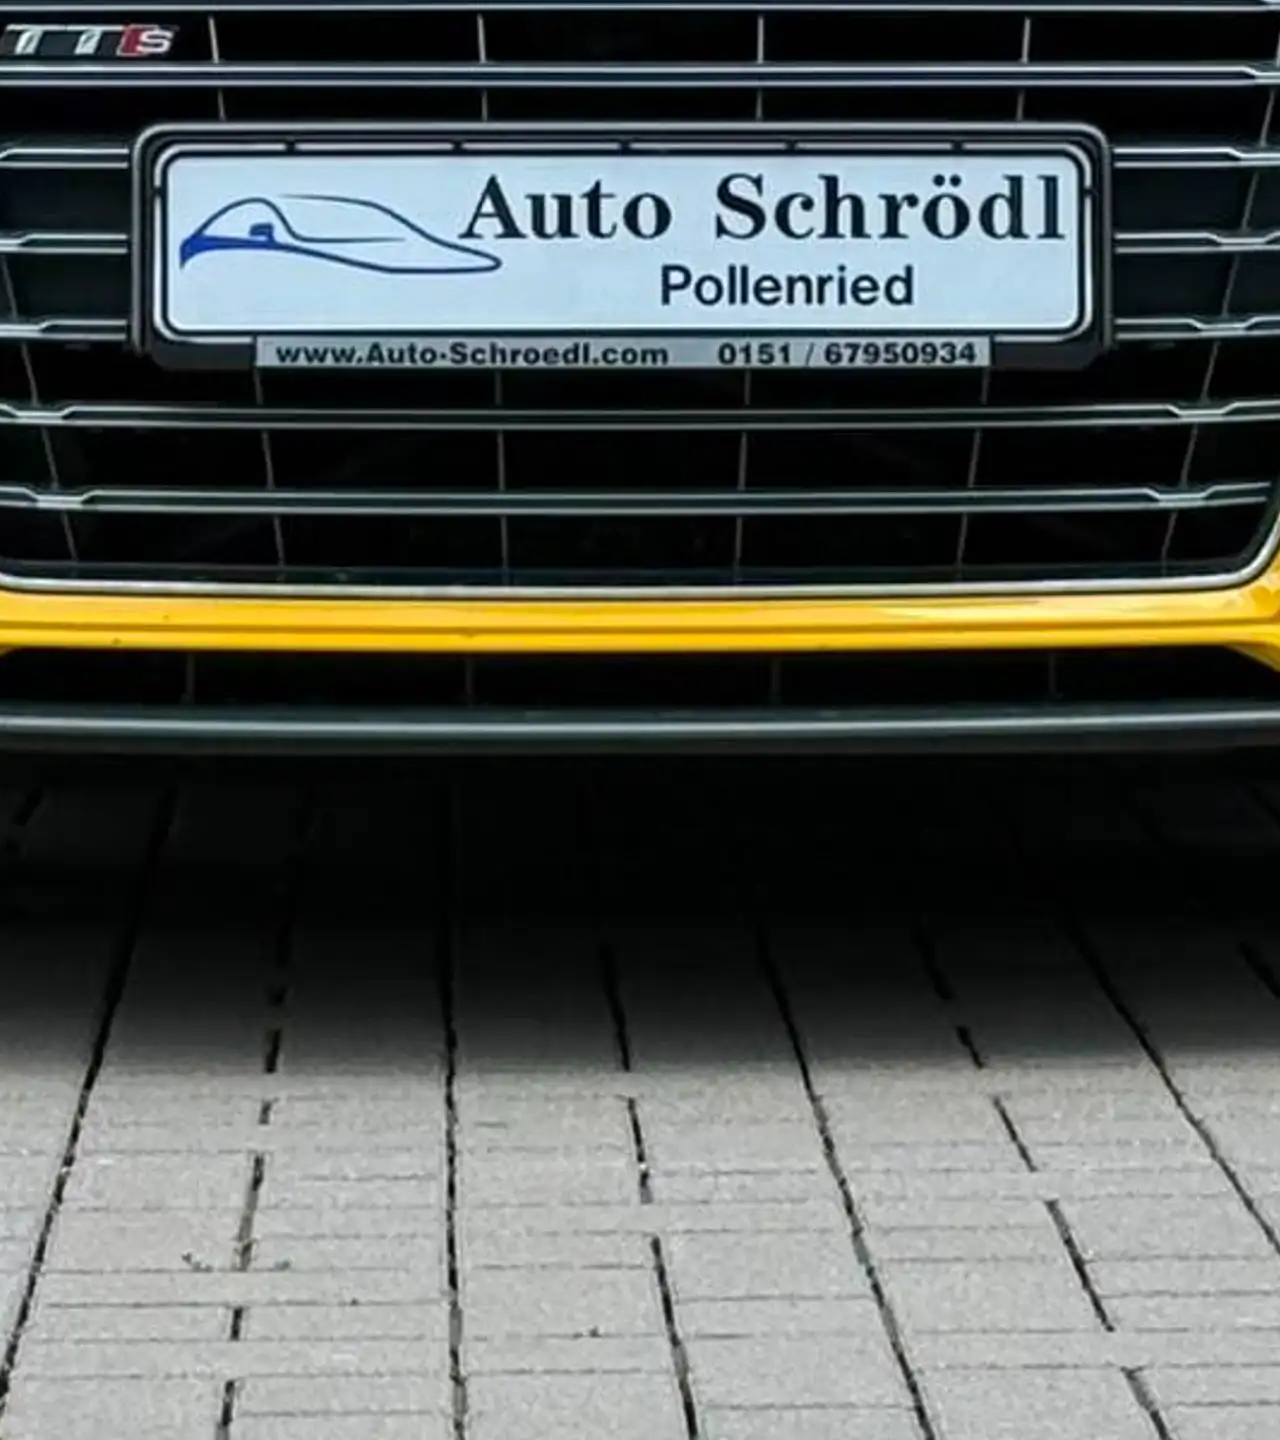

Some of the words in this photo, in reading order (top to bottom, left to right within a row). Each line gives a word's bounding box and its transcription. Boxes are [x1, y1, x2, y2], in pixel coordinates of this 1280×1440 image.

[4, 23, 175, 57] TTS
[459, 174, 673, 240] Auto
[715, 172, 1066, 240] Schrödl
[661, 264, 914, 307] Pollenried
[276, 340, 670, 368] www.Auto-Schroedl.com
[717, 340, 792, 367] 0151
[823, 340, 979, 367] 67950934
